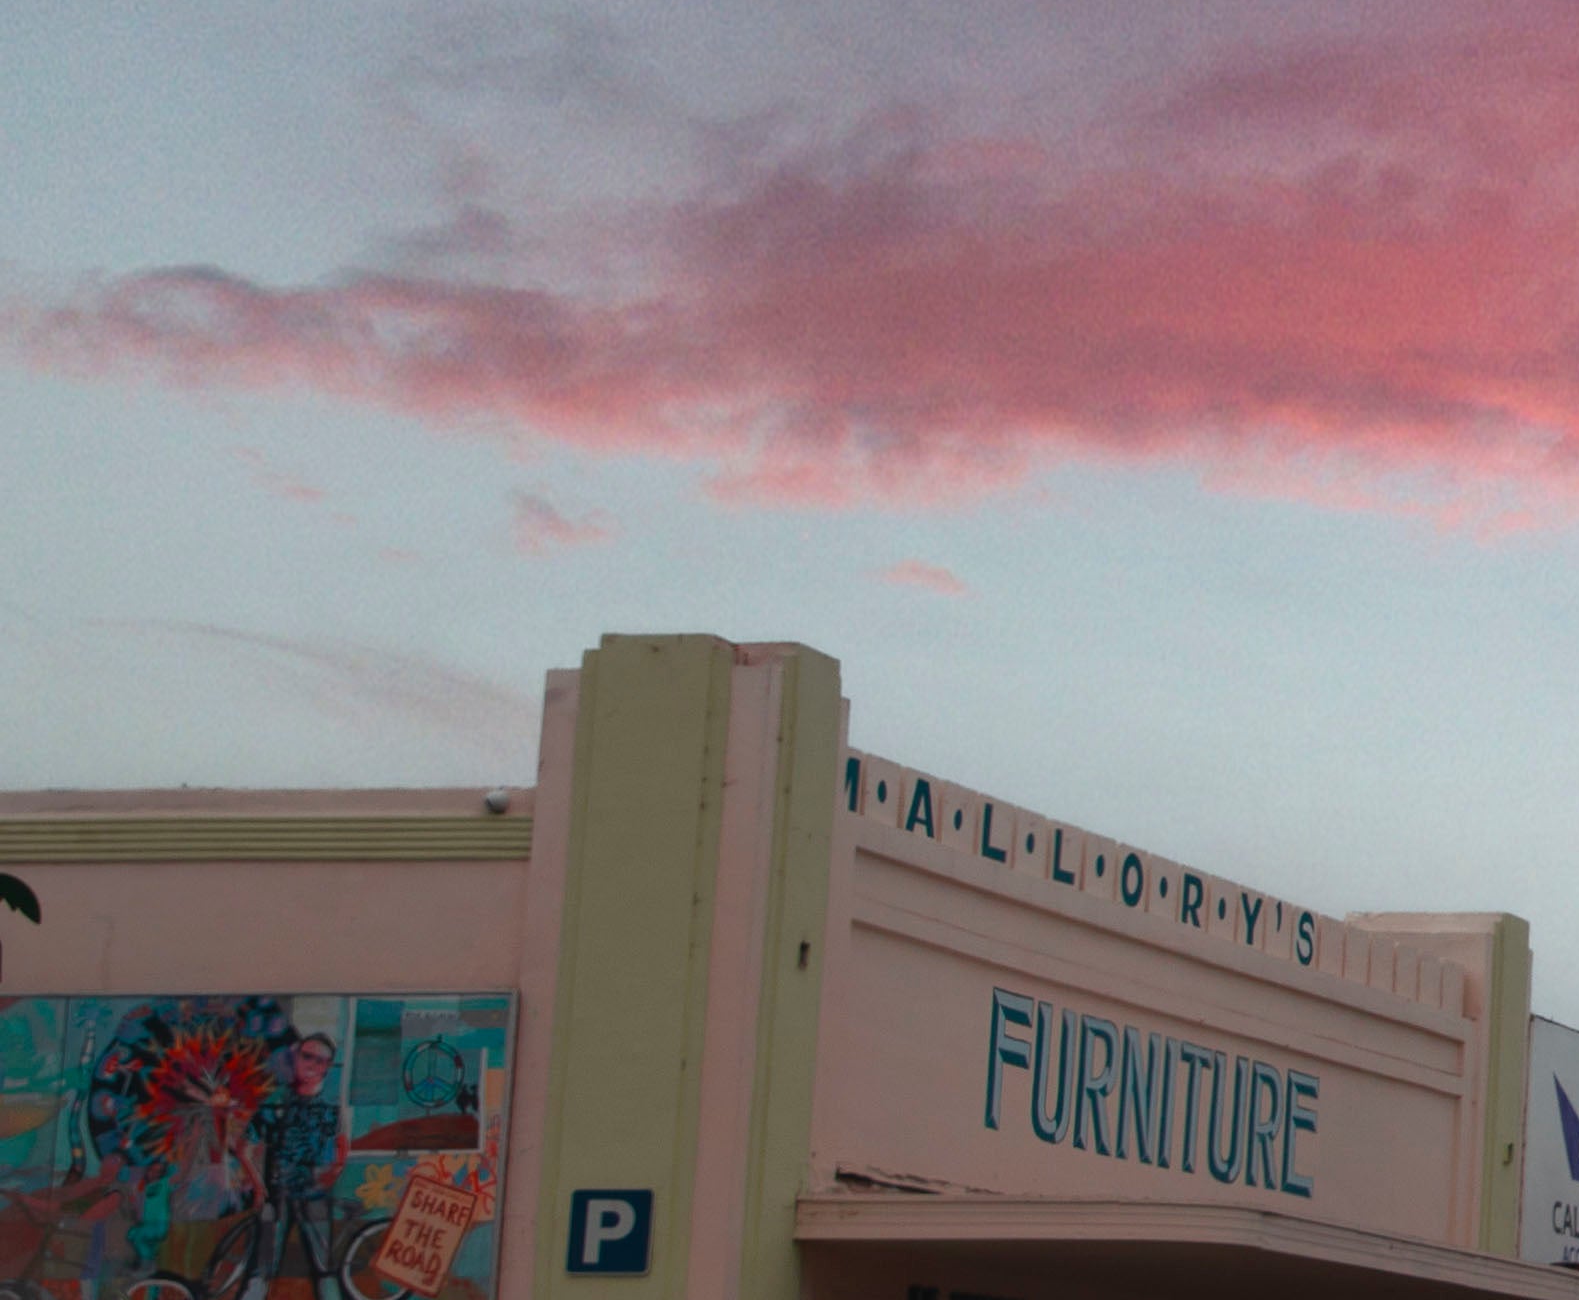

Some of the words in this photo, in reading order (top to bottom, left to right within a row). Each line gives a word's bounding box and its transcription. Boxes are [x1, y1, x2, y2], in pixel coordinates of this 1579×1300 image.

[983, 986, 1320, 1199] FURNITURE
[403, 1217, 447, 1251] THE
[583, 1198, 637, 1265] P
[385, 1239, 443, 1286] ROAD
